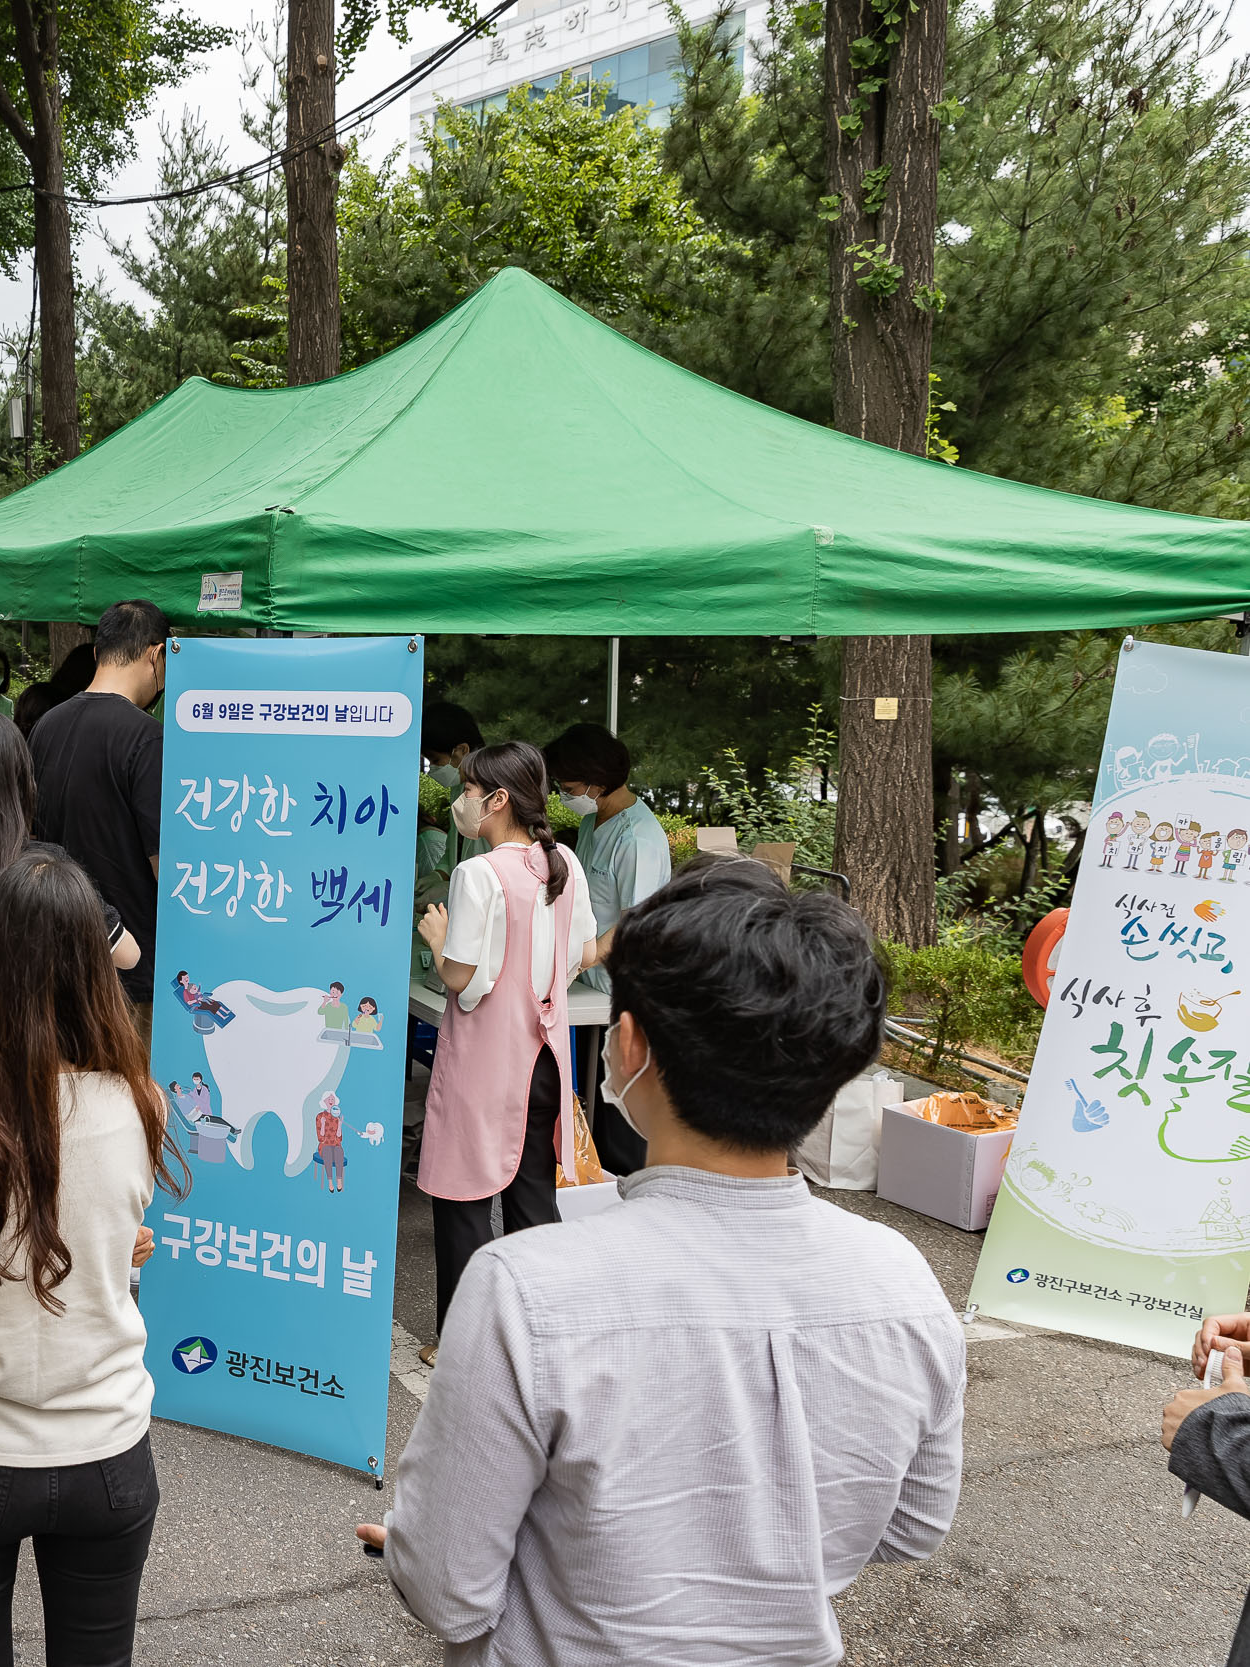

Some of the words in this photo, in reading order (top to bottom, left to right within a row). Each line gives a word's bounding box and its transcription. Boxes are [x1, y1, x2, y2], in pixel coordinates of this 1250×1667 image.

[192, 702, 214, 720] 6월
[218, 702, 255, 721] 9일은
[258, 703, 329, 722] 구강보건의
[334, 704, 394, 724] 날입니다
[174, 774, 298, 837] 건강한
[310, 781, 400, 837] 치아
[170, 859, 293, 923] 건강한
[310, 865, 393, 928] 백세
[161, 1213, 327, 1289] 구강보건의
[342, 1246, 378, 1298] 날
[1033, 1272, 1123, 1302] 광진구보건소
[1125, 1291, 1205, 1322] 구강보건실
[225, 1349, 346, 1399] 광진보건소
